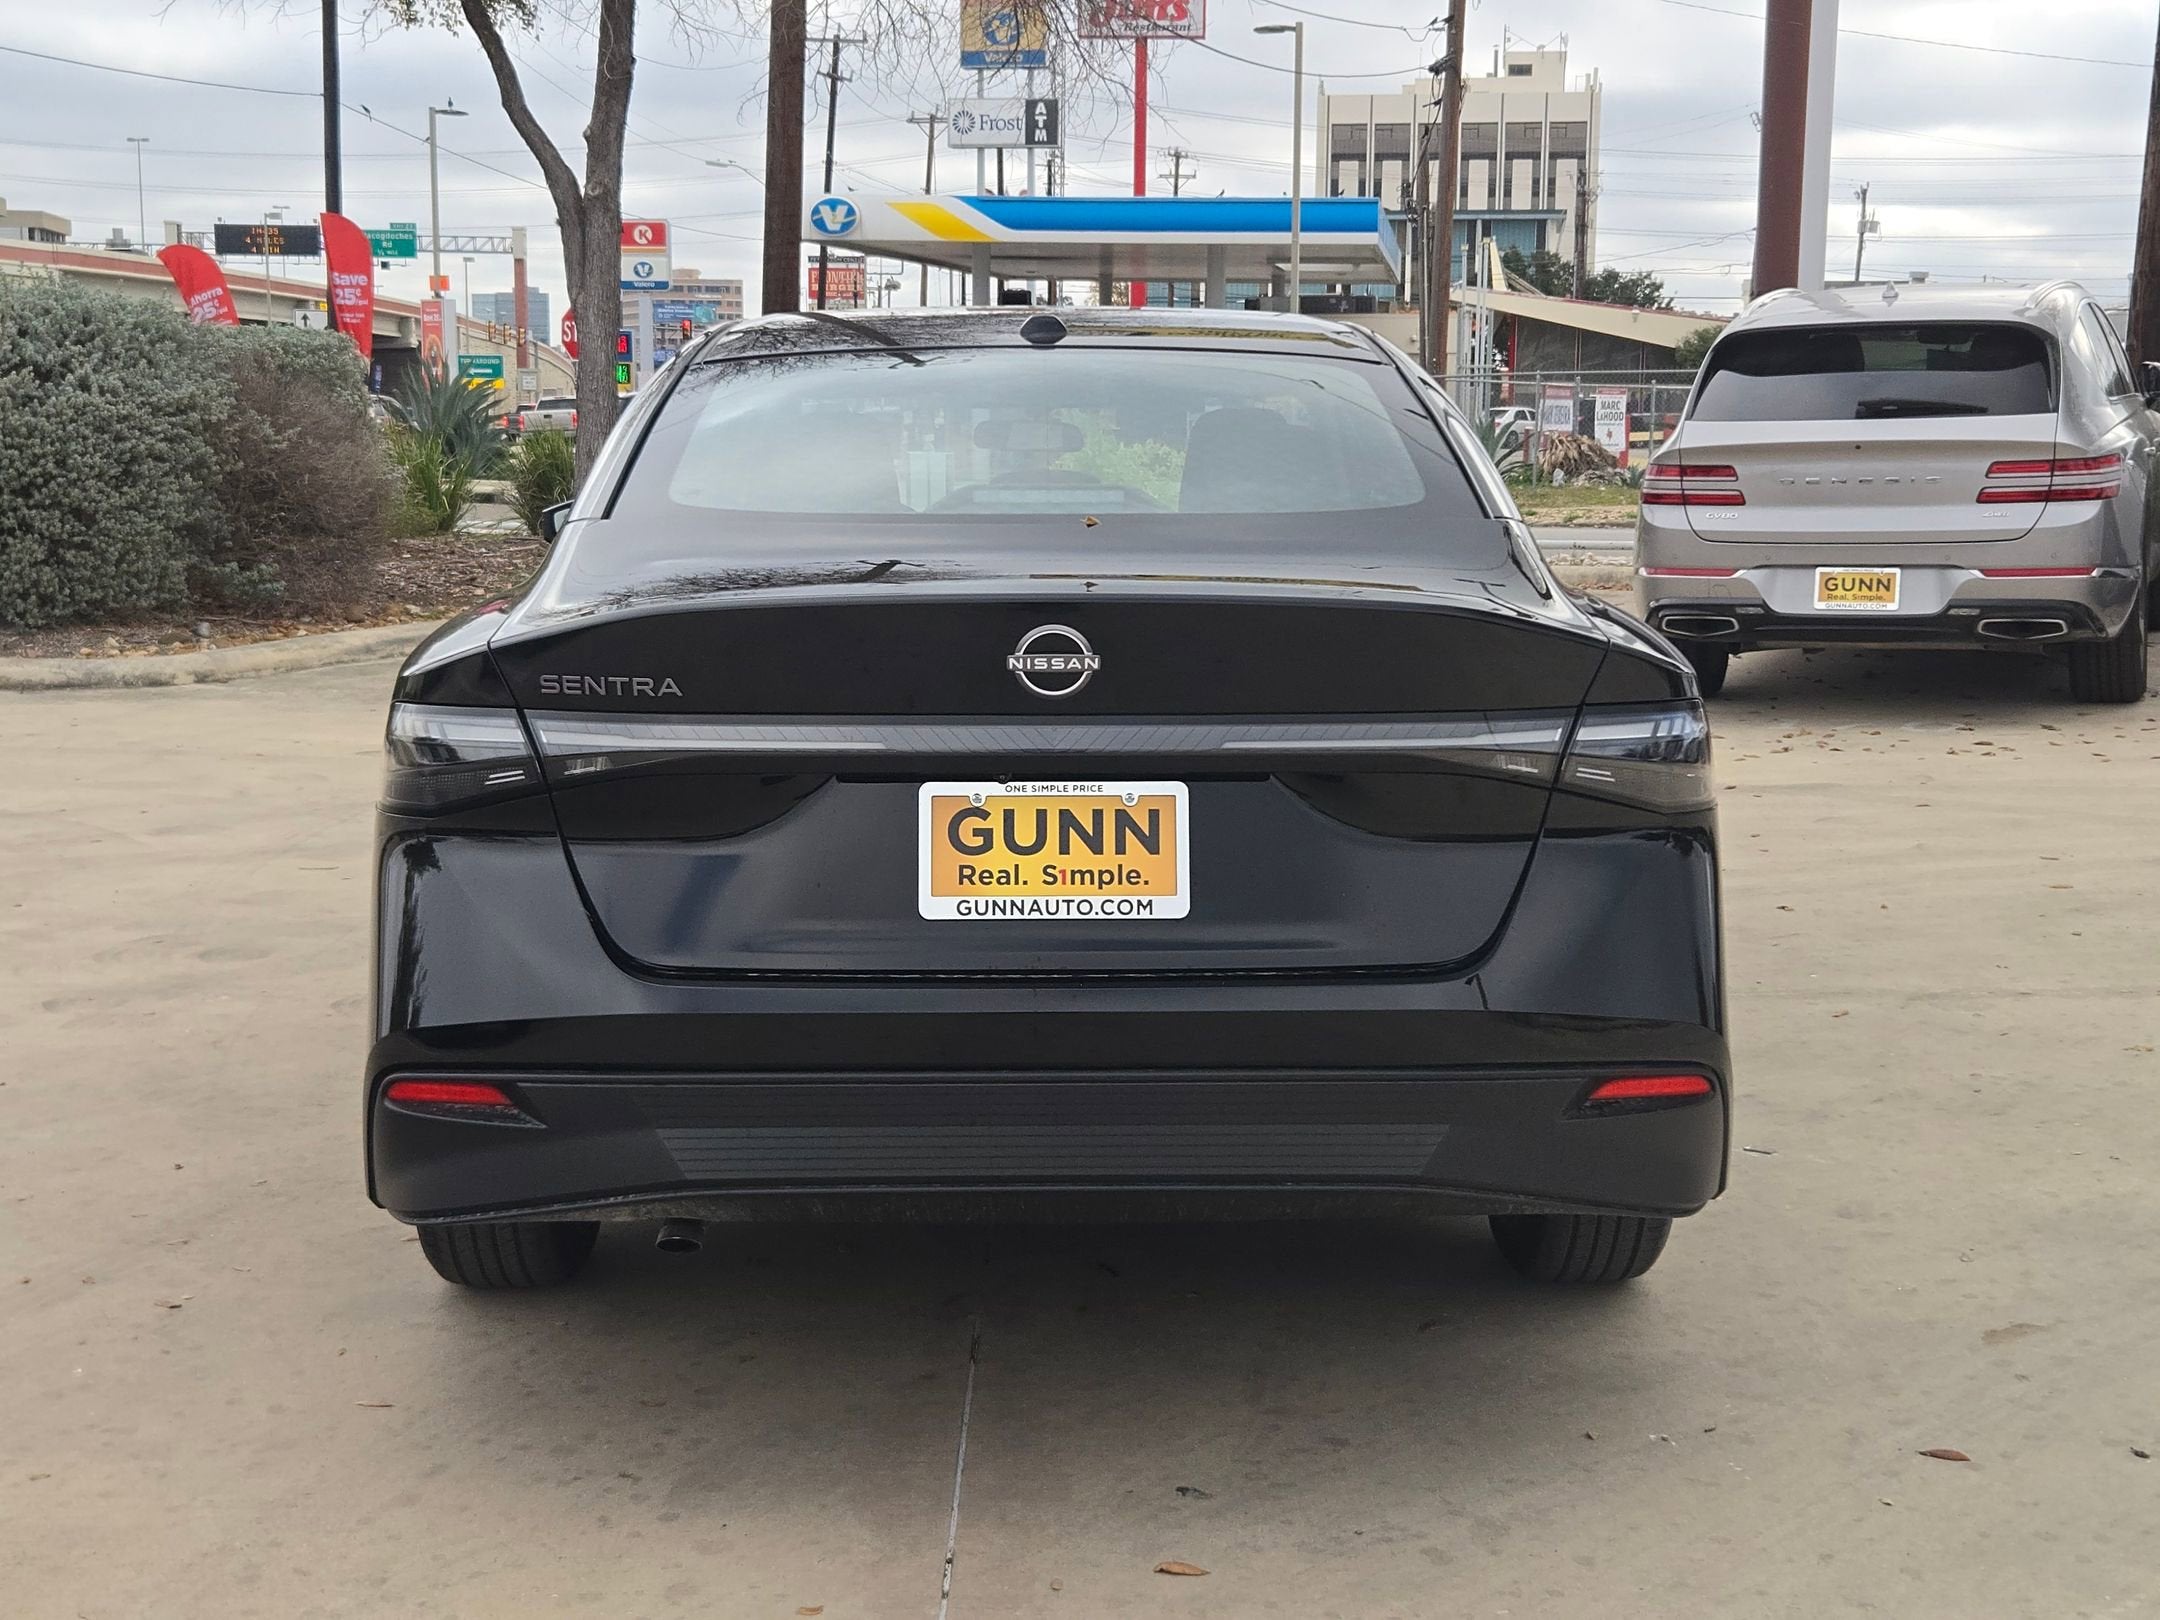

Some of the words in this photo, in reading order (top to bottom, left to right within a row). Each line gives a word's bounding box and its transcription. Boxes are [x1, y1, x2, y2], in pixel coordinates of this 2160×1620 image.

[979, 114, 1022, 131] Frost
[1034, 101, 1048, 142] ATM
[256, 236, 285, 245] MLES
[366, 232, 413, 240] acogdoches
[332, 272, 369, 286] Save
[811, 271, 865, 284] FONTIER
[811, 284, 865, 292] BRGER
[1600, 400, 1622, 411] MARC
[1824, 577, 1891, 592] GUNN
[1827, 593, 1850, 601] Real.
[1008, 657, 1099, 670] NISSAN
[539, 674, 684, 697] SENTRA
[1005, 785, 1029, 793] ONE
[1031, 785, 1070, 793] SIMPLE
[1073, 785, 1104, 793] PRICE
[947, 806, 1160, 857] GUNN
[958, 864, 1029, 886] Real.
[956, 899, 1154, 916] GUNNAUTO.COM
